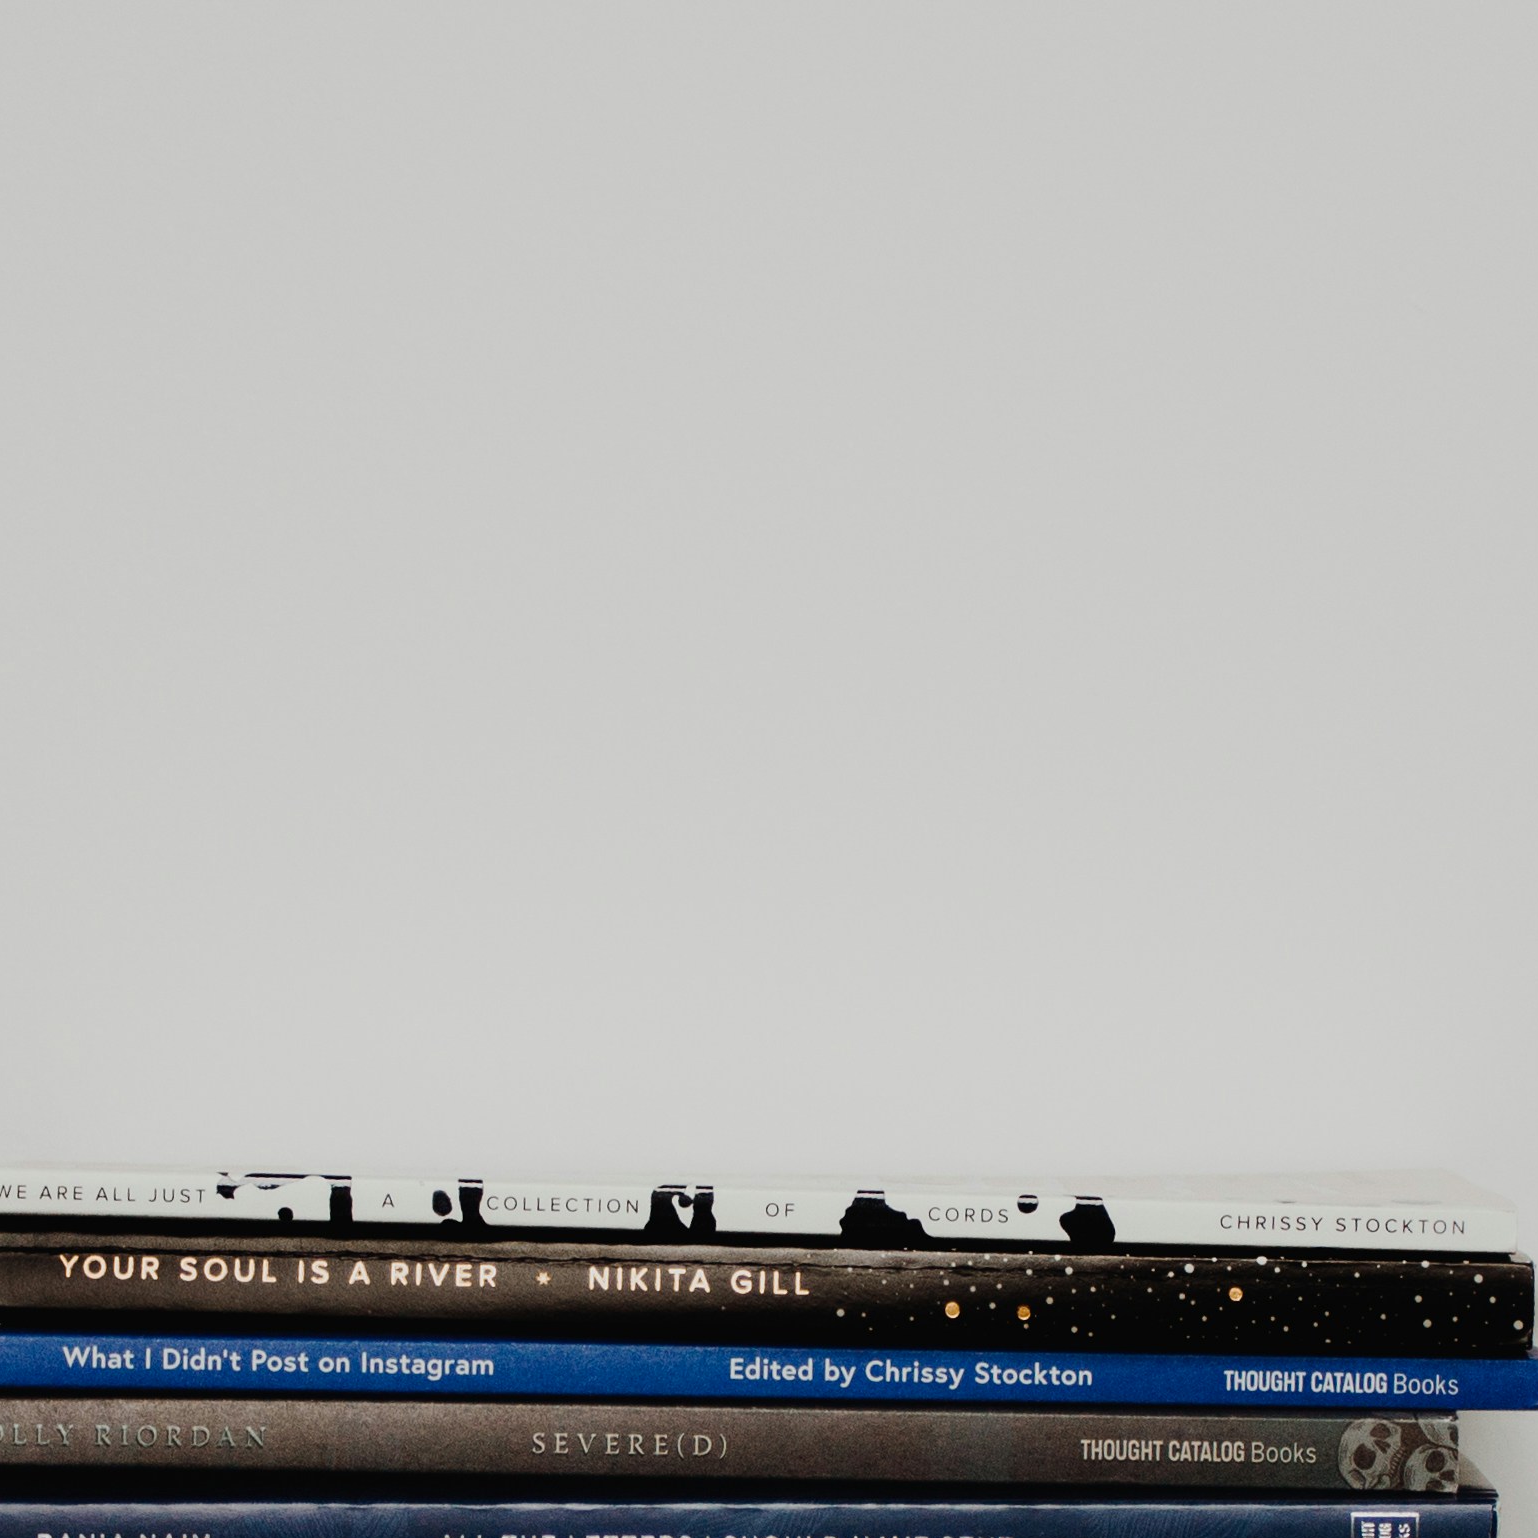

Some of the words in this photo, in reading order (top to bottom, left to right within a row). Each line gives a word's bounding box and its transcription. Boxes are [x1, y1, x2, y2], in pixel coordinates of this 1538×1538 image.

[40, 1186, 82, 1201] ARE
[96, 1187, 136, 1202] ALL
[149, 1189, 206, 1204] JUST
[382, 1194, 395, 1208] A
[486, 1196, 641, 1215] COLLECTION
[766, 1203, 795, 1218] OF
[928, 1207, 1009, 1224] CORDS
[1220, 1215, 1323, 1232] CHRISSY
[1336, 1218, 1465, 1235] STOCKTON
[60, 1255, 160, 1281] YOUR
[180, 1257, 277, 1284] SOUL
[298, 1260, 330, 1285] IS
[349, 1261, 371, 1285] A
[391, 1262, 498, 1288] RIVER
[588, 1266, 711, 1293] NIKITA
[731, 1269, 810, 1296] GILL
[63, 1345, 135, 1370] What
[146, 1348, 152, 1370] I
[163, 1347, 242, 1372] Didn't
[252, 1349, 309, 1373] Post
[319, 1357, 351, 1373] on
[362, 1352, 494, 1381] Instagram
[730, 1357, 814, 1381] Edited
[825, 1358, 857, 1388] by
[866, 1359, 965, 1390] Chrissy
[975, 1362, 1093, 1386] Stockton
[1224, 1370, 1307, 1393] THOUGHT
[1311, 1372, 1388, 1394] CATALOG
[1394, 1373, 1459, 1396] Books
[95, 1423, 268, 1450] RIORDAN
[533, 1432, 727, 1458] SEVERE(D)
[1081, 1439, 1164, 1461] THOUGHT
[1169, 1440, 1245, 1463] CATALOG
[1252, 1441, 1317, 1464] Books
